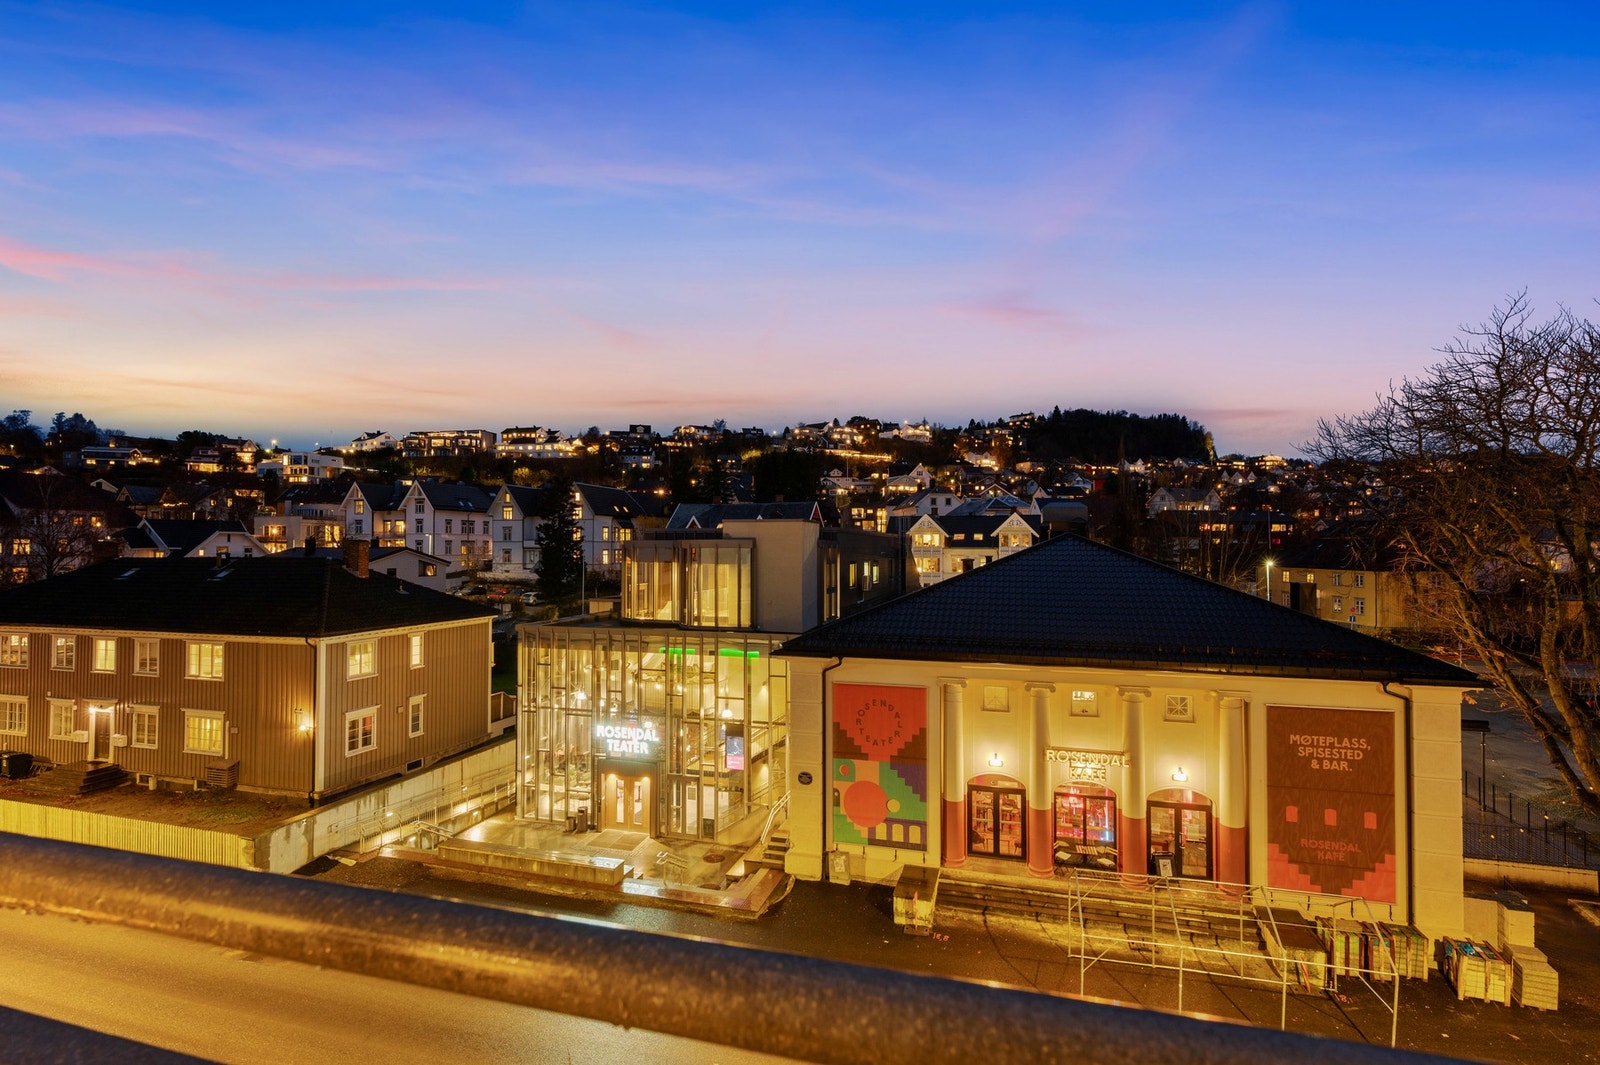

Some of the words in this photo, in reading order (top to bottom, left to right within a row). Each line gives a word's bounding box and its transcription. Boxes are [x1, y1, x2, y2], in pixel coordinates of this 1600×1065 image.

[856, 699, 902, 729] ROSENDAL
[596, 725, 659, 741] ROSENDAL
[859, 728, 900, 746] TEATER
[606, 739, 649, 754] TEATER
[1289, 734, 1371, 750] MØTEPLASS,
[1046, 749, 1130, 768] ROSENDAL
[1297, 747, 1364, 760] SPISESTED
[1311, 759, 1320, 770] &
[1323, 760, 1352, 771] BAR.
[1300, 838, 1361, 853] ROSENDAL
